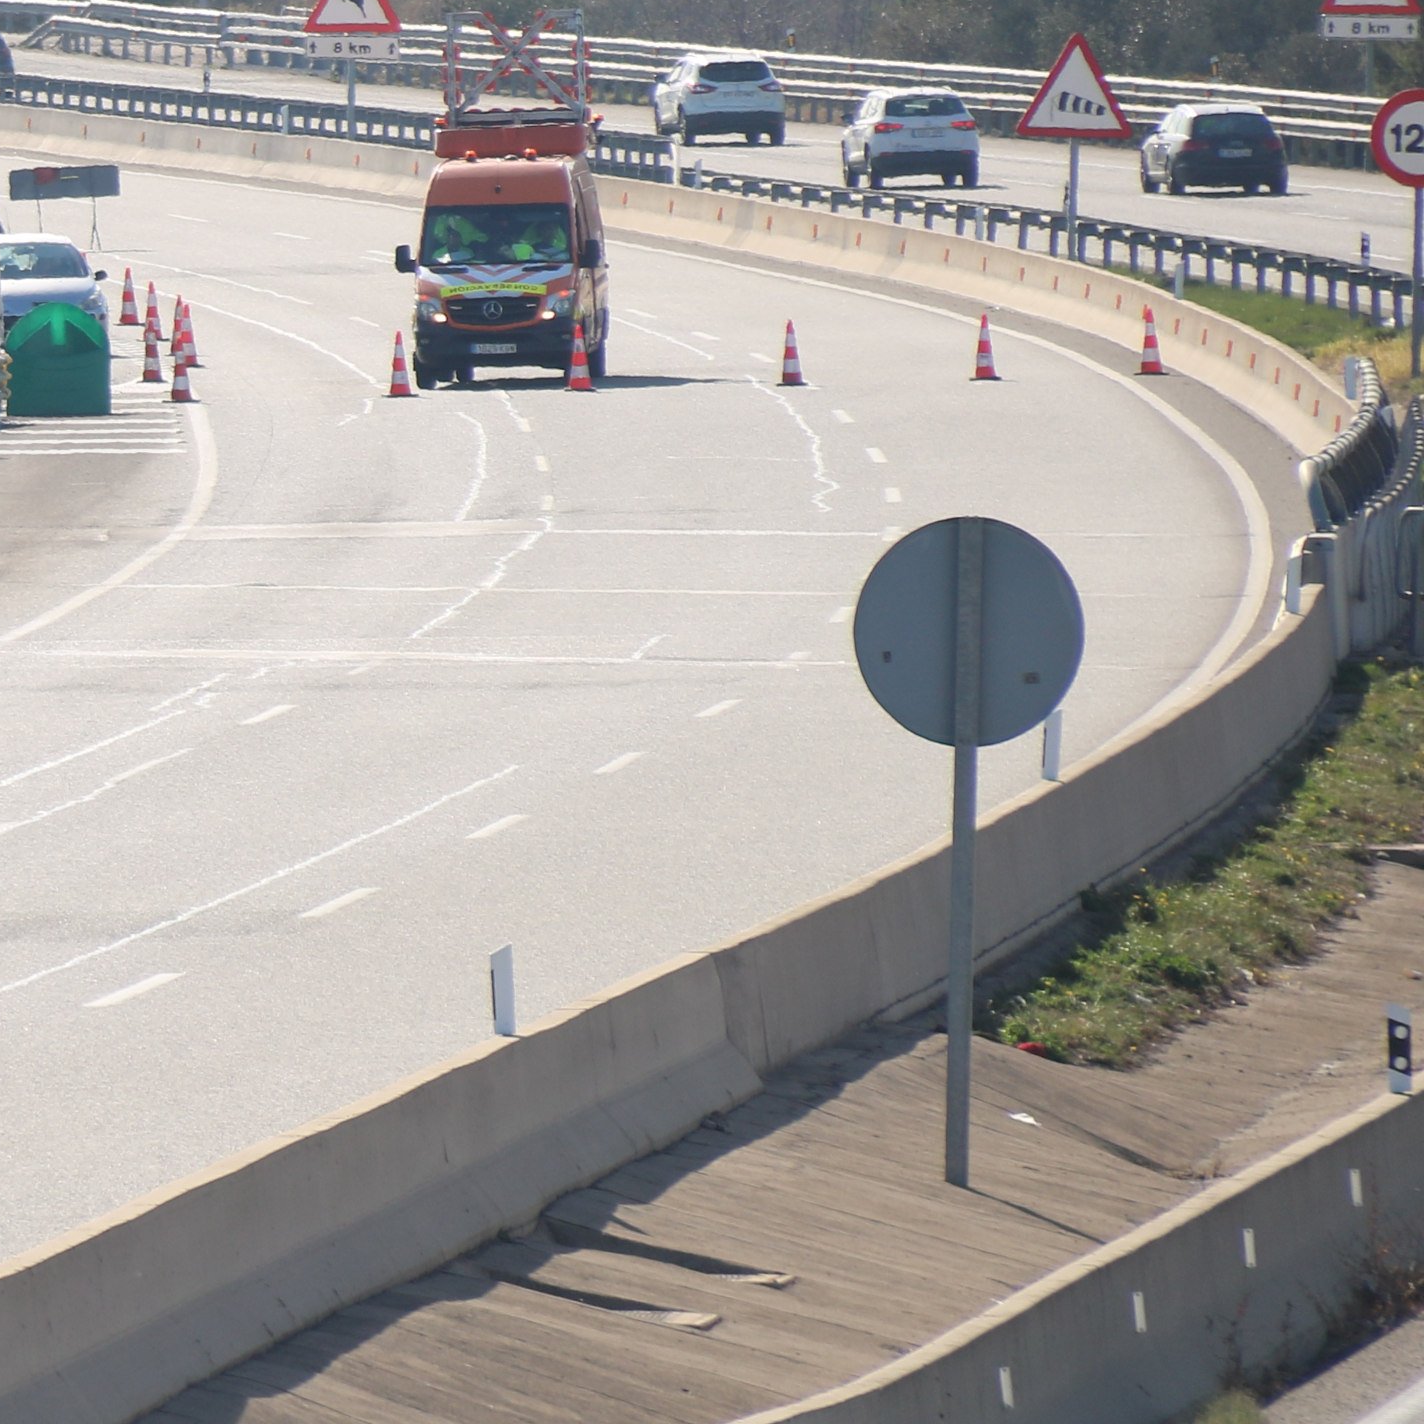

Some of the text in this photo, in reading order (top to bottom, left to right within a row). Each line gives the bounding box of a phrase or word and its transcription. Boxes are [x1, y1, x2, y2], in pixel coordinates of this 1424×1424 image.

[1352, 22, 1390, 34] 8 km
[333, 42, 372, 54] 8 km
